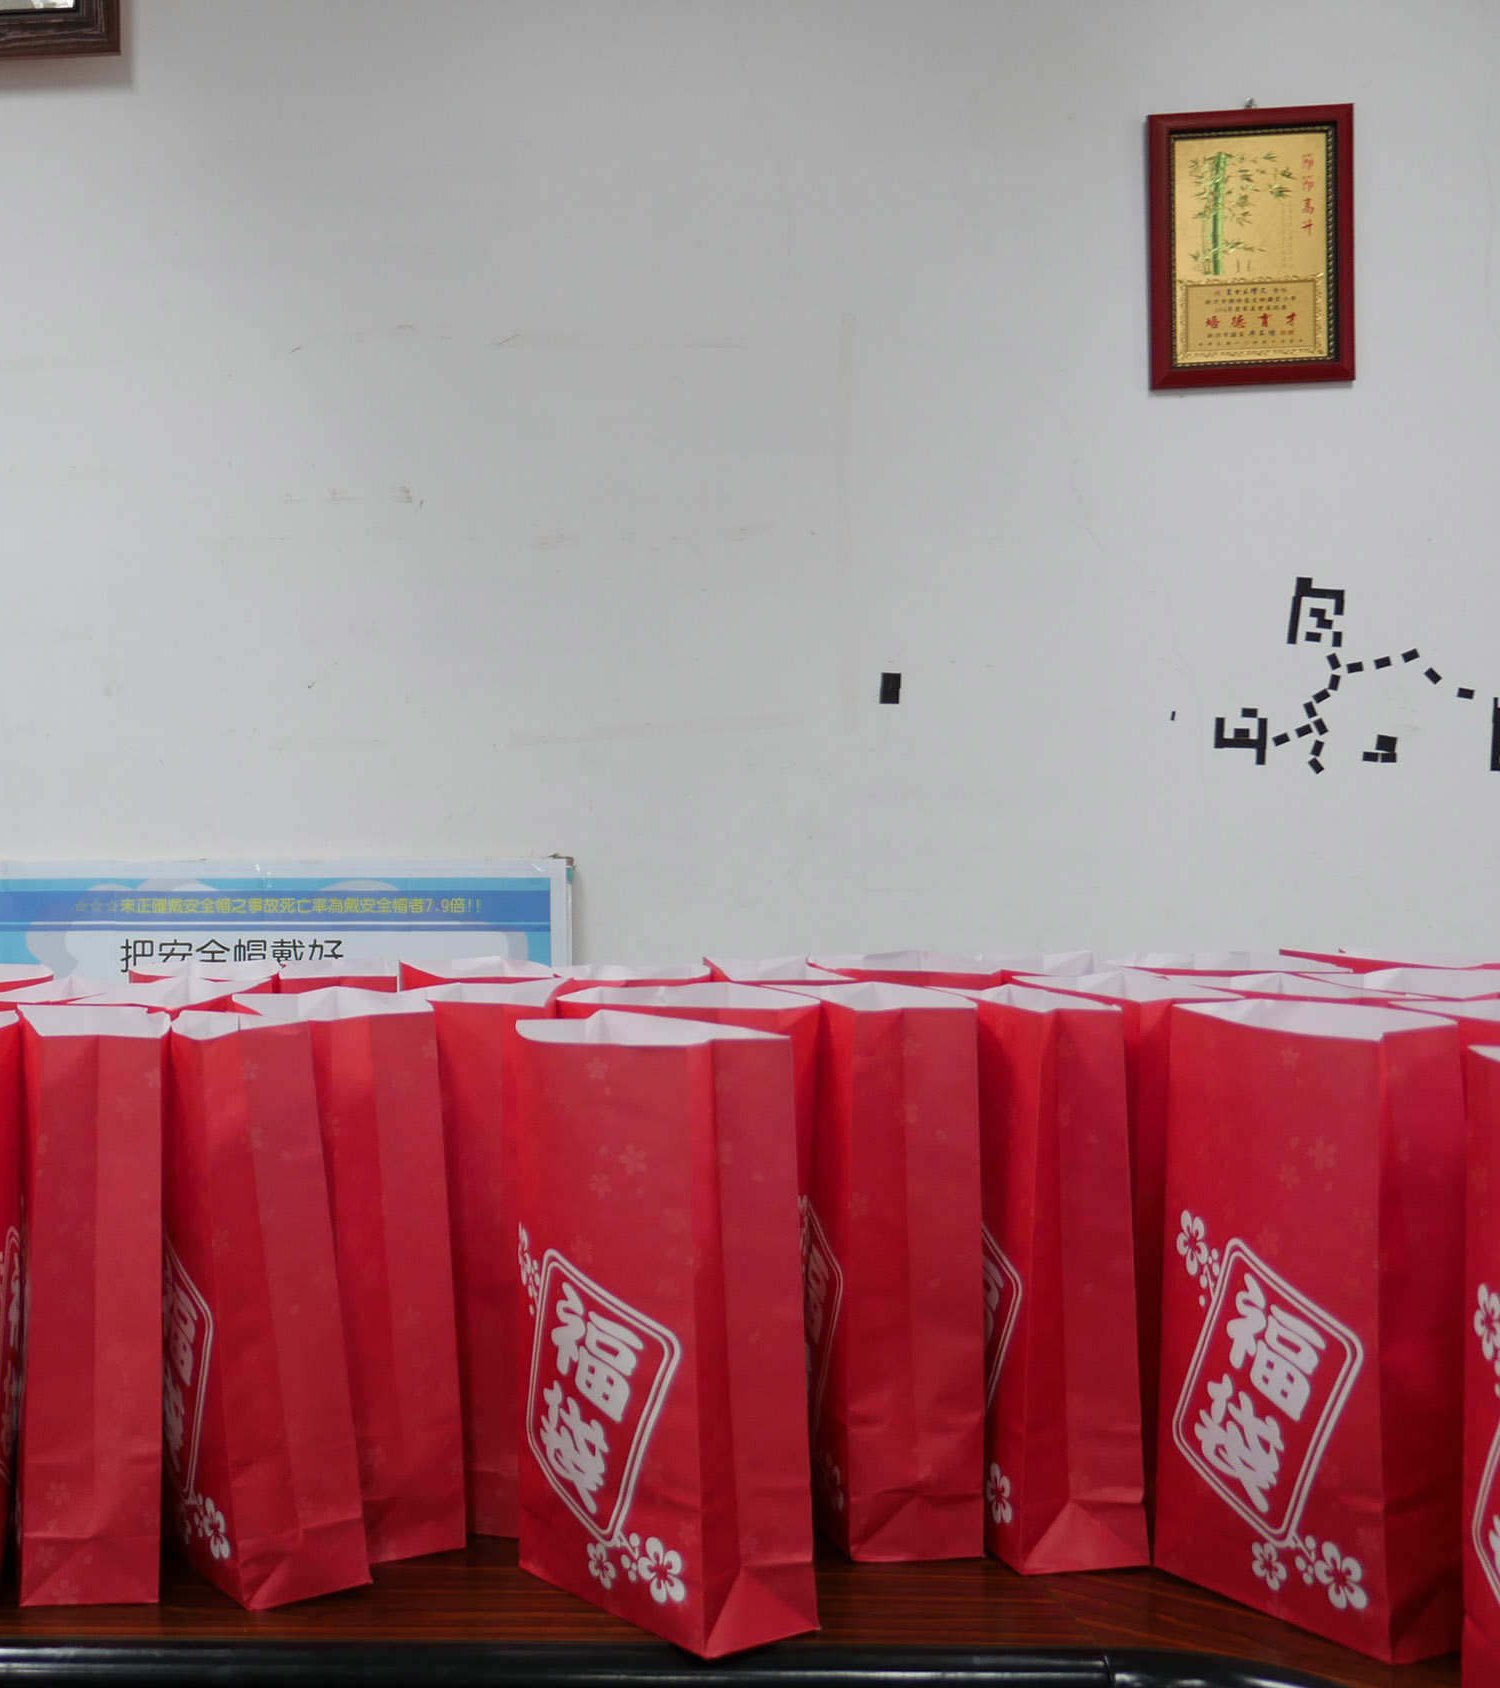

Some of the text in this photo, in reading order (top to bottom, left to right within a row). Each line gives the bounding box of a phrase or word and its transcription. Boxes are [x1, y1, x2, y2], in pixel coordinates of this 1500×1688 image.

[120, 938, 344, 970] 把安全帽戴好
[539, 1281, 644, 1515] 福袋
[1193, 1272, 1326, 1514] 福袋
